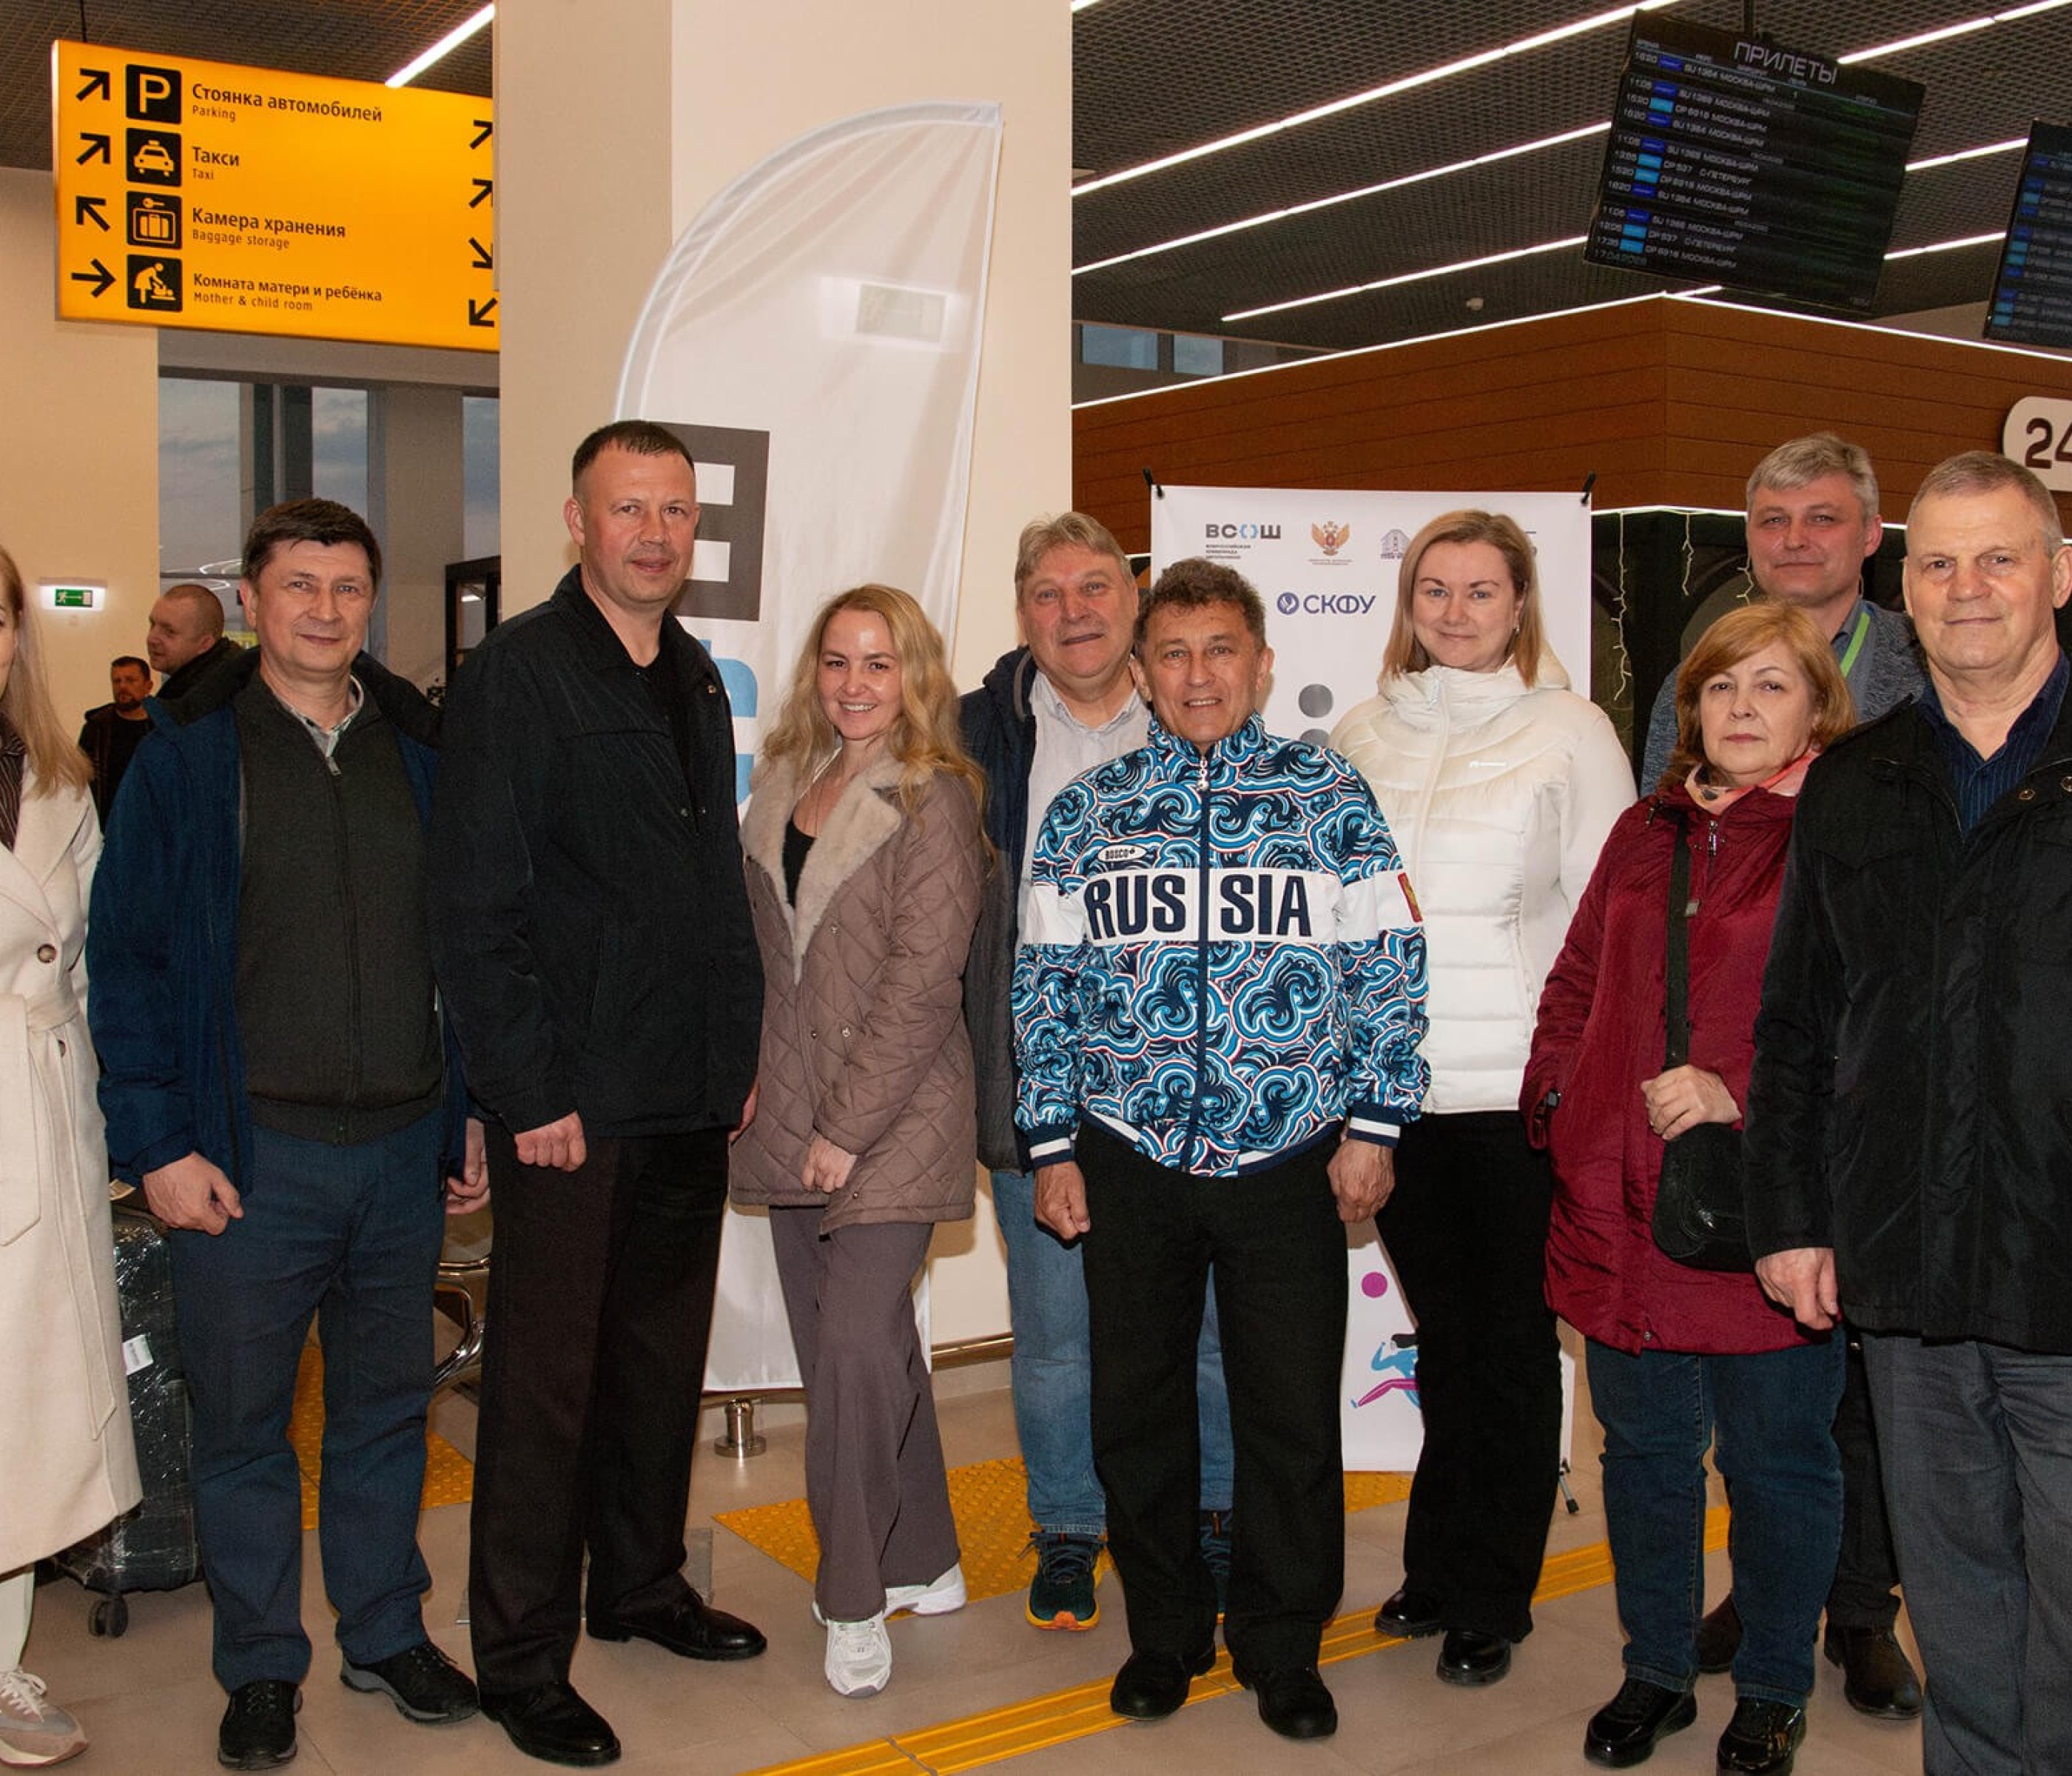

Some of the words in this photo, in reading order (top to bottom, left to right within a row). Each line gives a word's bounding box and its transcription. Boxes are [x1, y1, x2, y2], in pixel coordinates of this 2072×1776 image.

[1734, 41, 1837, 84] ПРИЛЕТЫ
[138, 74, 171, 114] P
[192, 83, 262, 108] Стоянка
[267, 94, 382, 123] автомобилей
[192, 104, 236, 122] Parking
[192, 147, 240, 166] Такси
[192, 168, 214, 181] Taxi
[192, 208, 259, 232] Камера
[264, 218, 346, 238] хранения
[192, 229, 242, 246] Baggage
[246, 234, 290, 249] storage
[193, 273, 255, 292] Комната
[258, 280, 309, 298] матери
[314, 286, 322, 297] и
[326, 283, 382, 302] ребёнка
[194, 292, 233, 306] Mother
[238, 295, 246, 306] &
[252, 295, 278, 309] child
[283, 300, 313, 312] room
[1303, 594, 1376, 614] СКФУ
[1105, 848, 1129, 860] BOSCO
